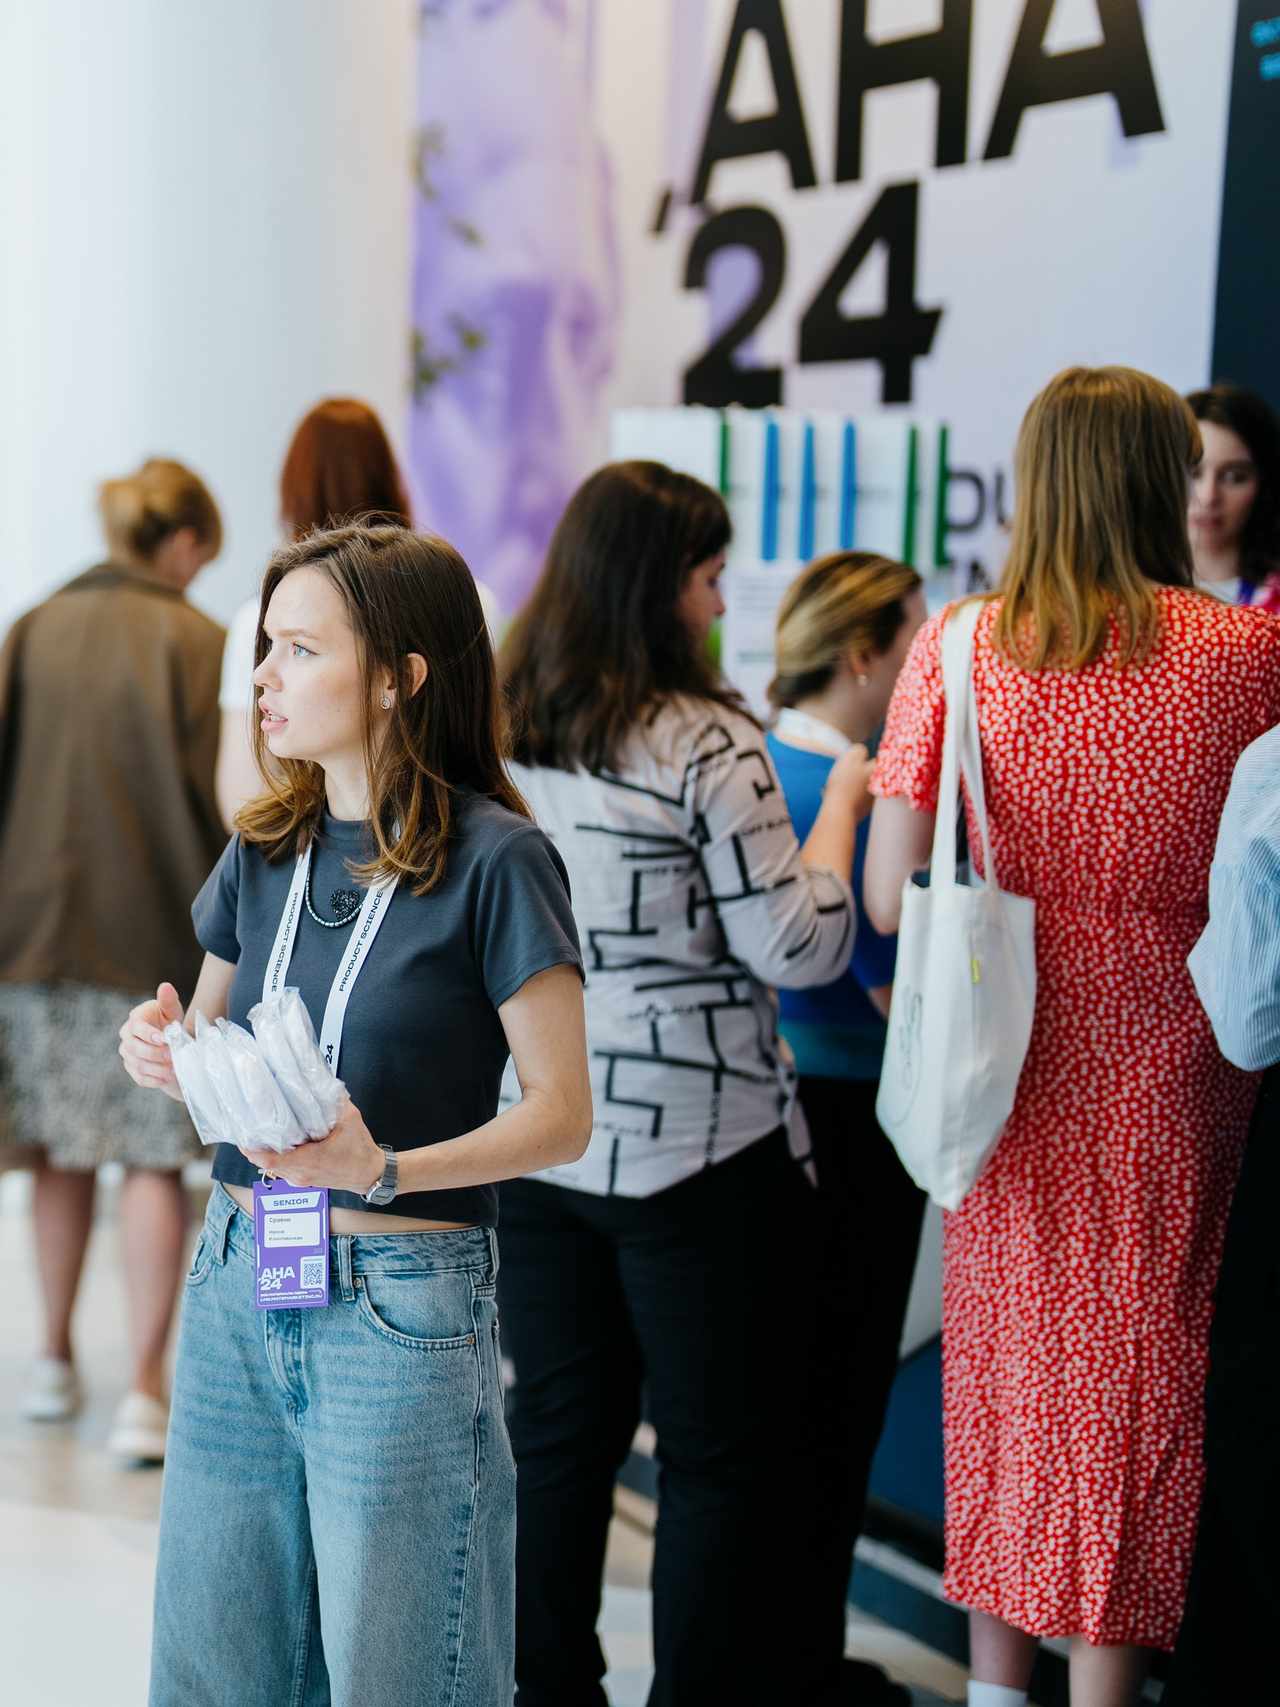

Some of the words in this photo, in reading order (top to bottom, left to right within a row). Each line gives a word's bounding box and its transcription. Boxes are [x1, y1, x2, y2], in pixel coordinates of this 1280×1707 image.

[690, 0, 1167, 206] AHA
[283, 892, 298, 943] PRODUCT
[339, 940, 363, 992] PRODUCT
[360, 890, 384, 940] SCIENCE
[271, 944, 287, 992] SCIENCE
[273, 1198, 309, 1207] SENIOR
[261, 1266, 296, 1280] AHA
